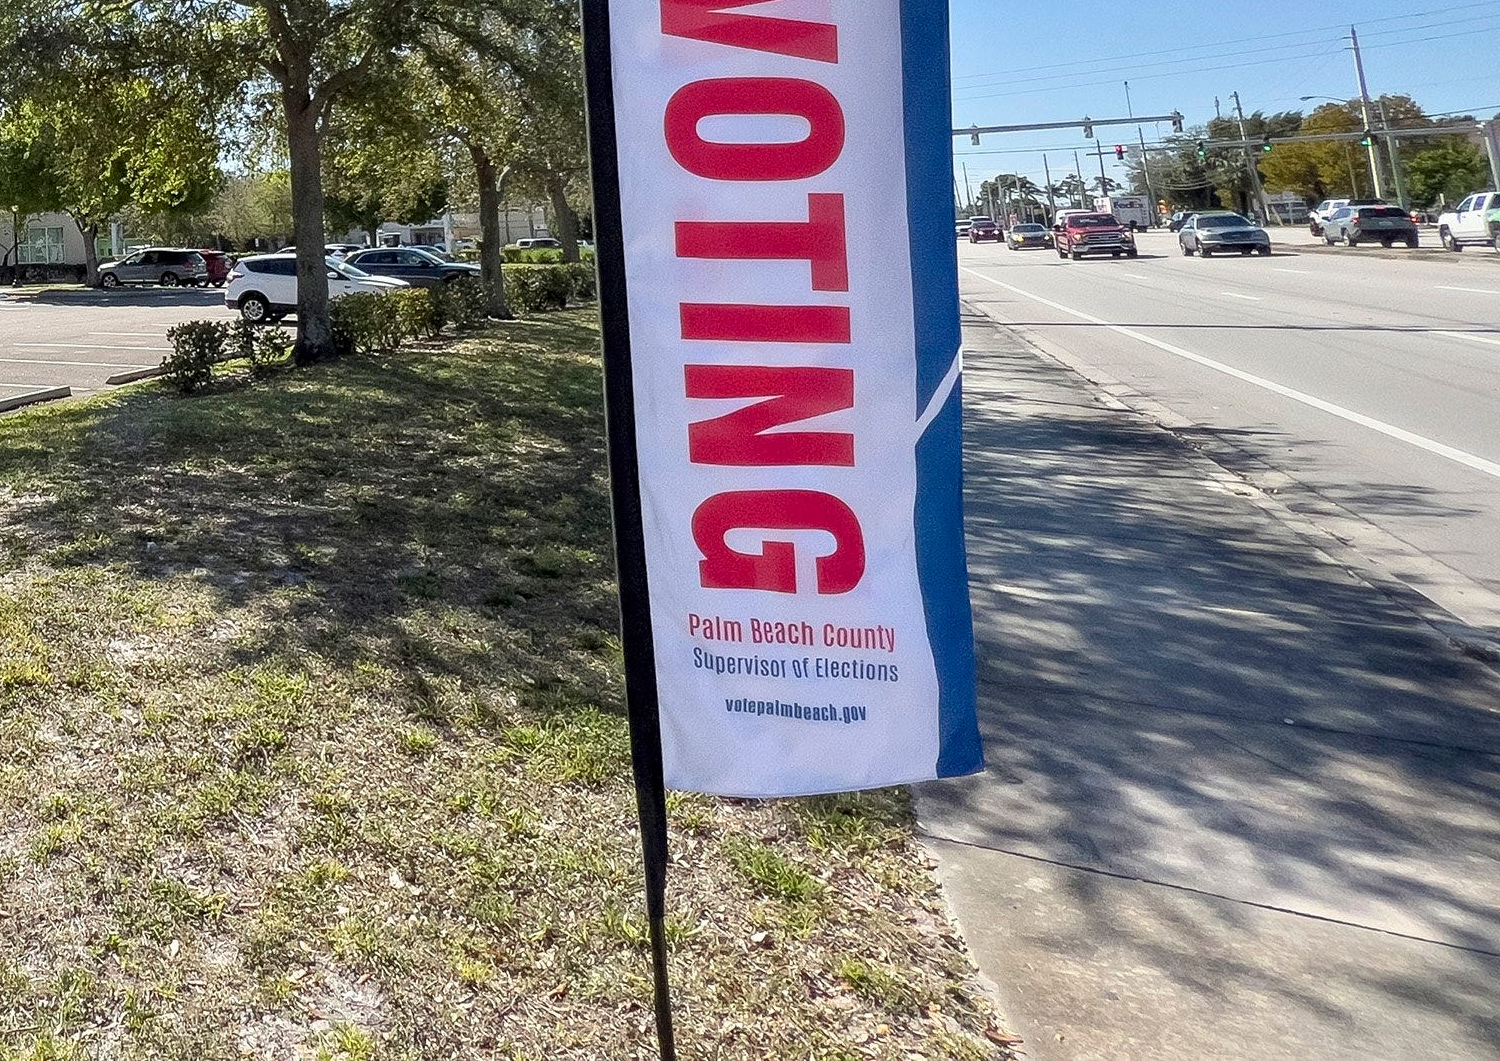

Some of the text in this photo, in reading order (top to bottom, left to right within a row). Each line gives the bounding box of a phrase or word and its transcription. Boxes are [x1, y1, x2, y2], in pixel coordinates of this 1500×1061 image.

[688, 613, 896, 653] Palm Beach County
[693, 647, 899, 682] Supervisor of Elections
[725, 697, 867, 724] votepalmbeach.gov
